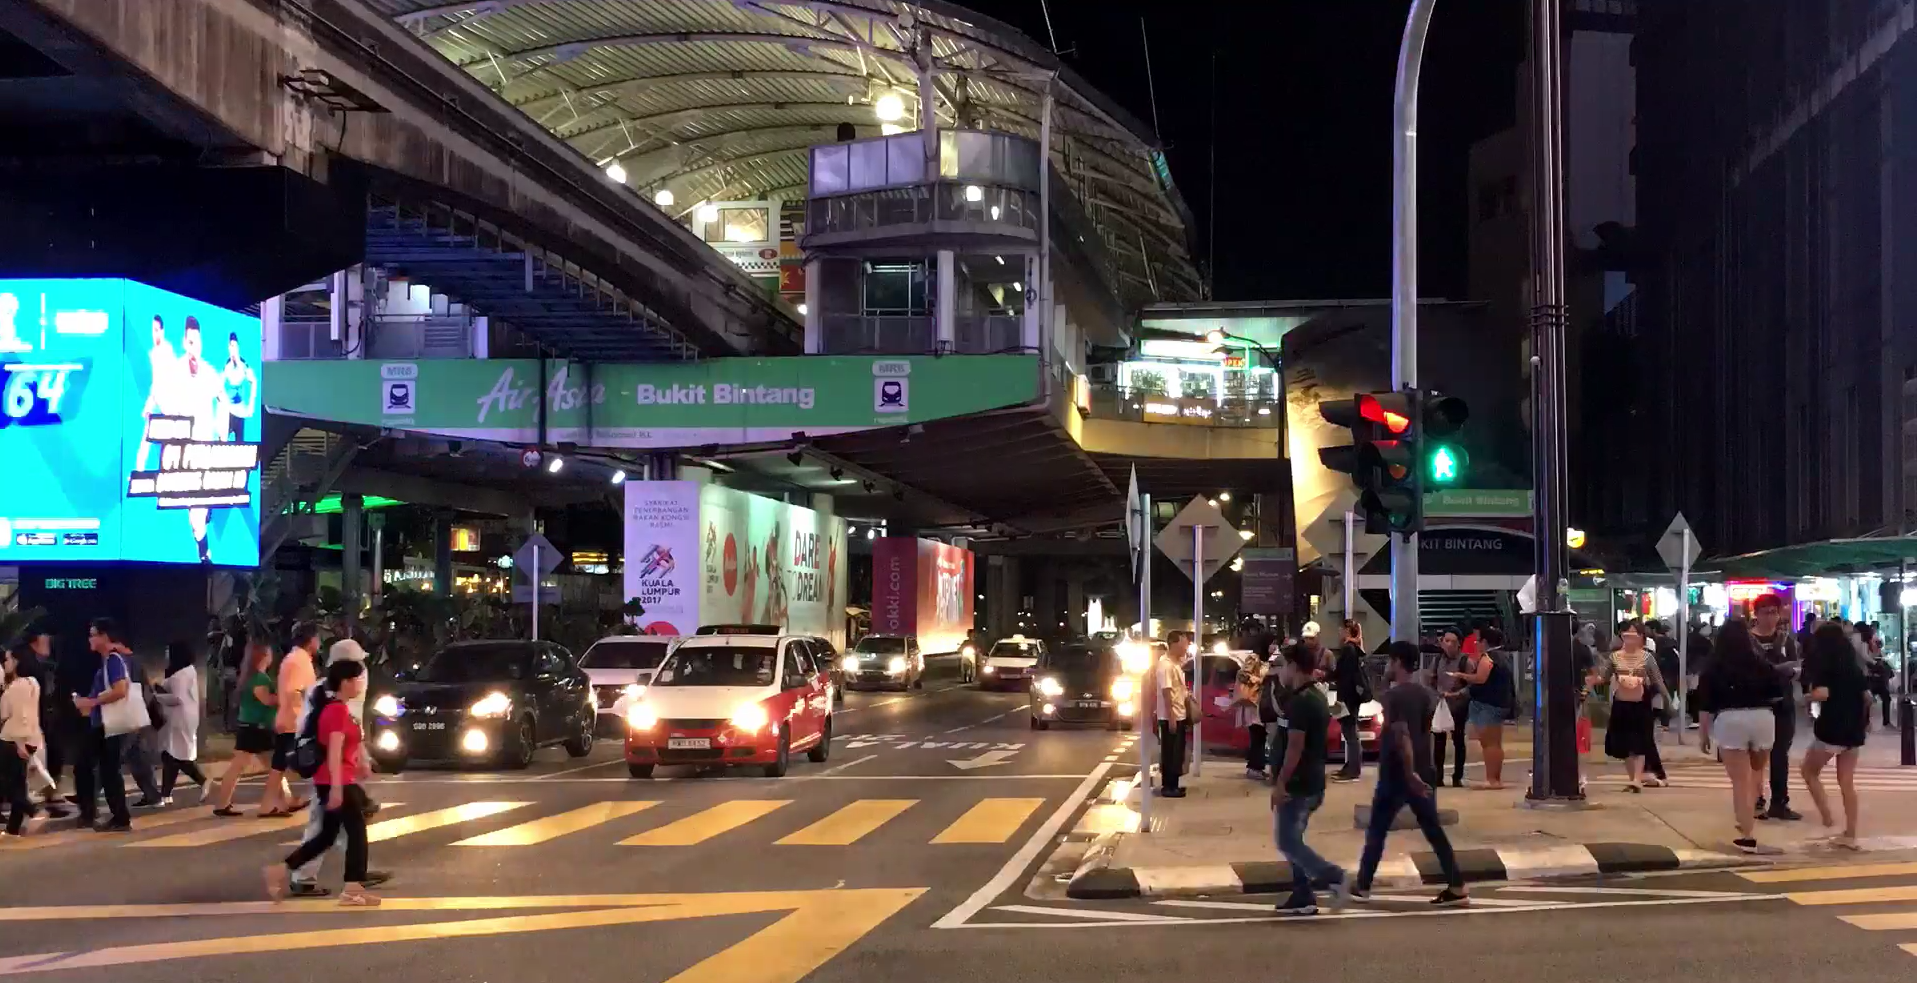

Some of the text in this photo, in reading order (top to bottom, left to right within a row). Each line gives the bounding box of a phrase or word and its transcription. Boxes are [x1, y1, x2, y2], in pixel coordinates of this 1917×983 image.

[637, 384, 815, 409] Bukit Bintang
[794, 530, 820, 569] DARE
[1445, 539, 1502, 550] BINTANG
[641, 588, 681, 596] LUMPUR
